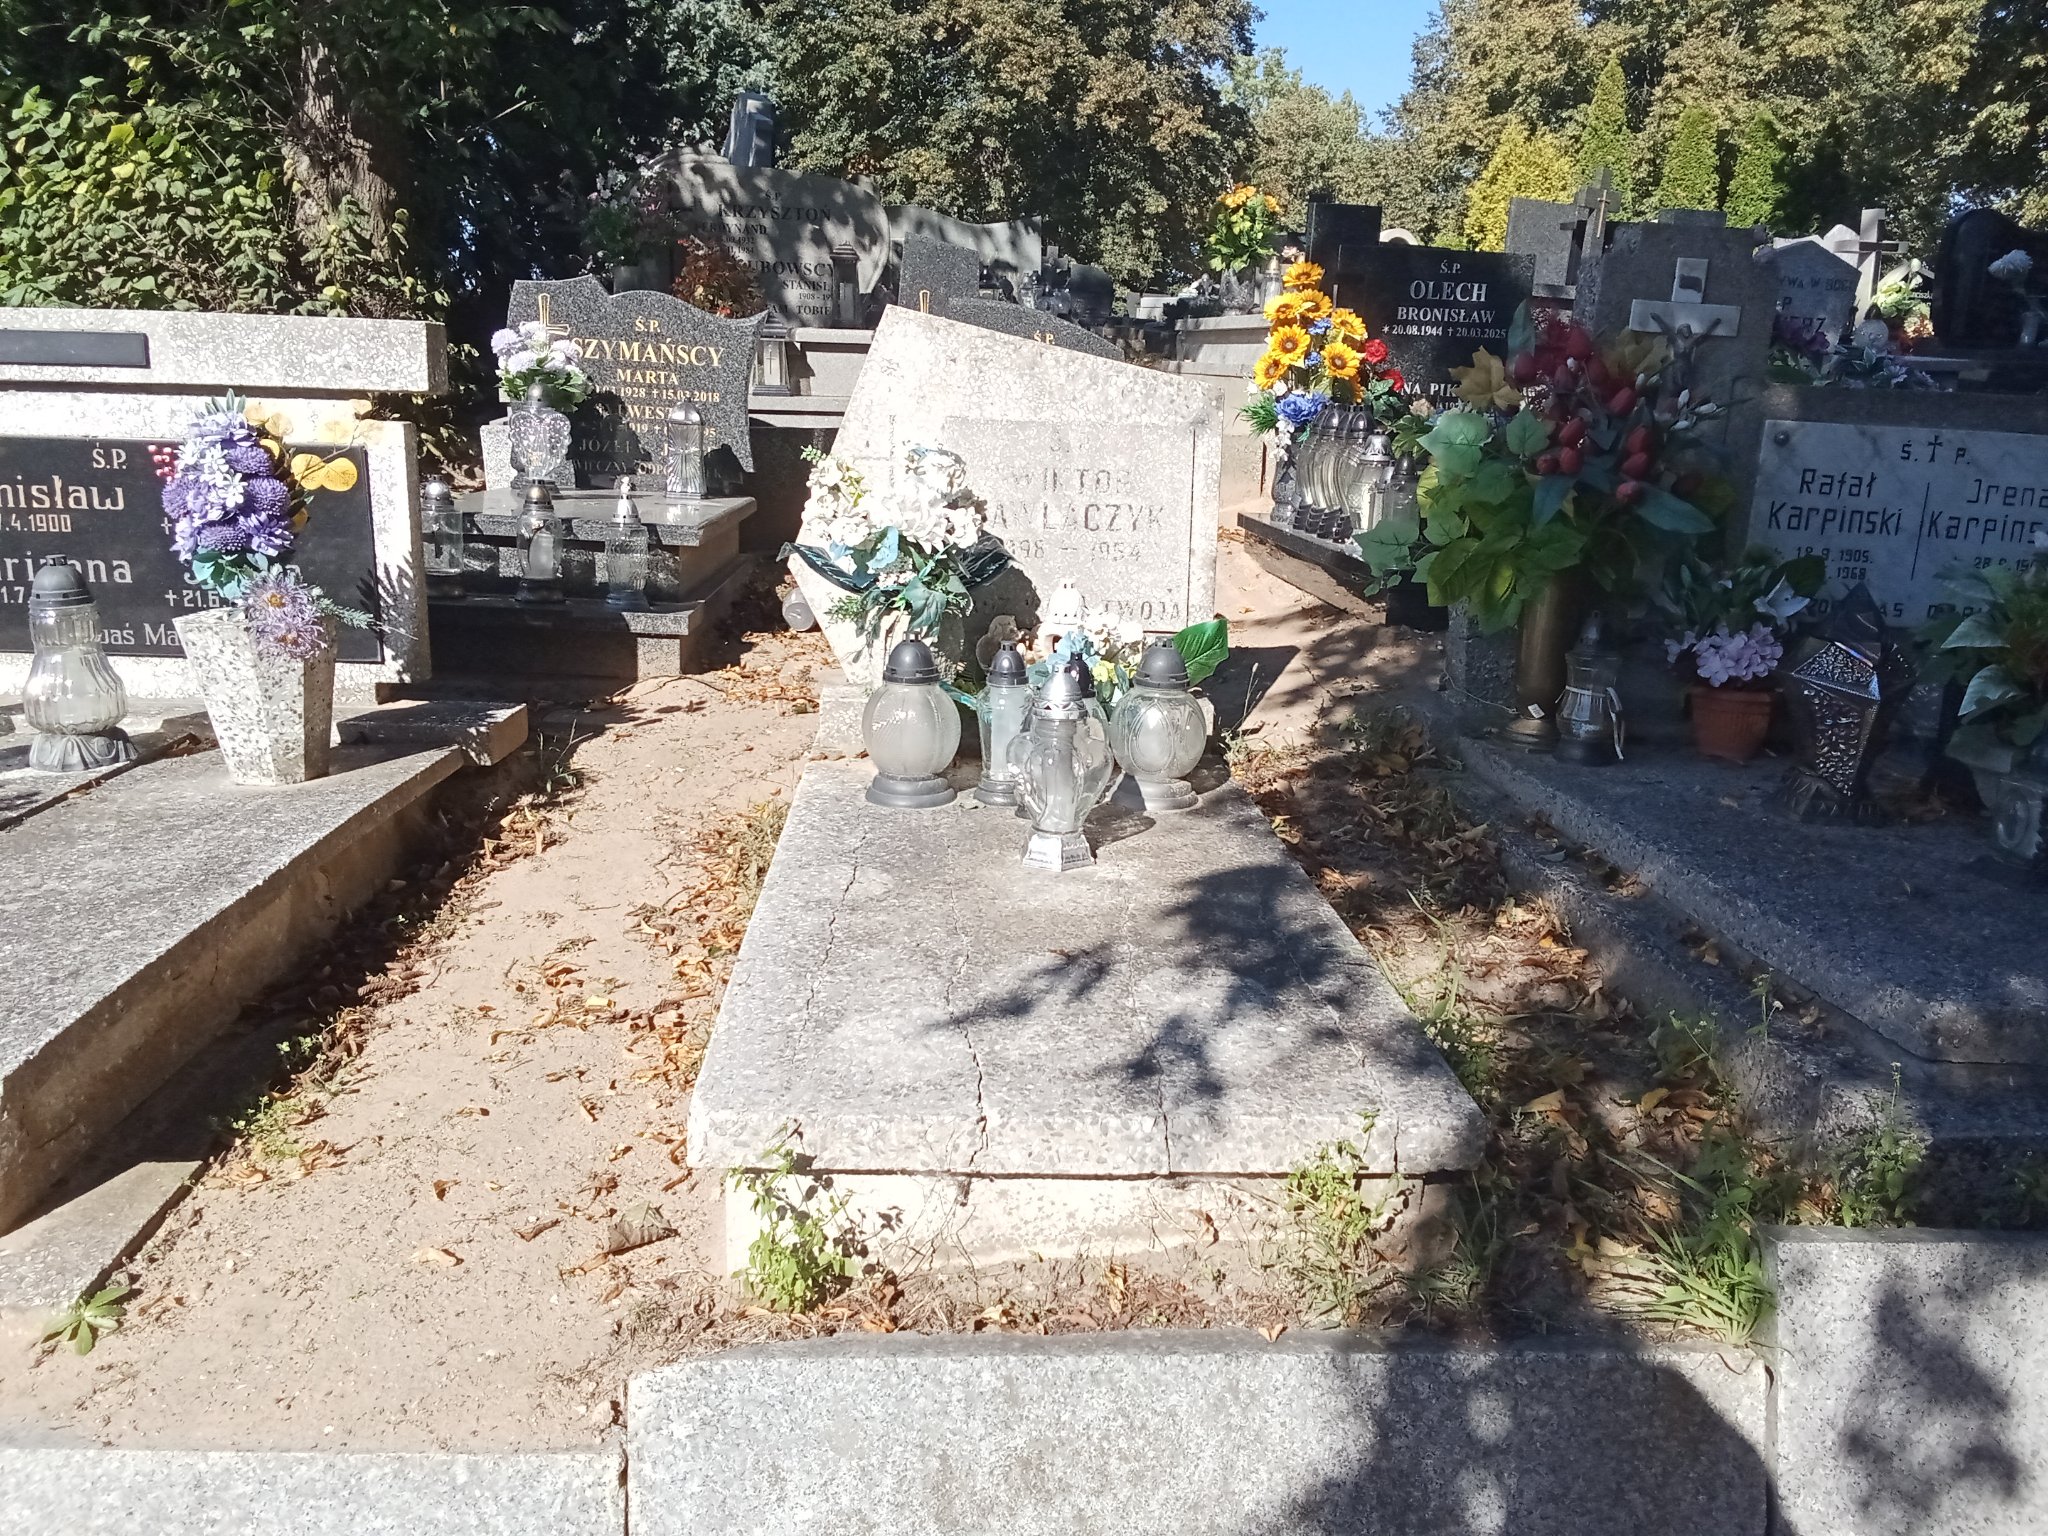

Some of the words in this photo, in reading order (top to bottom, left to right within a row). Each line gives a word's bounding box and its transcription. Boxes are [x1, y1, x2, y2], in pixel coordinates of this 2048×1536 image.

[1409, 279, 1488, 302] OLECH
[1397, 305, 1497, 324] BRONISŁAW
[1392, 324, 1443, 337] 20.08.1944
[1456, 327, 1507, 339] 20.03.2025
[571, 336, 724, 368] SZYMAŃSCY
[616, 368, 679, 386] MARTA
[92, 442, 127, 470] Ś.P.
[1799, 468, 1877, 499] Rafał
[1927, 510, 2043, 545] Karpins
